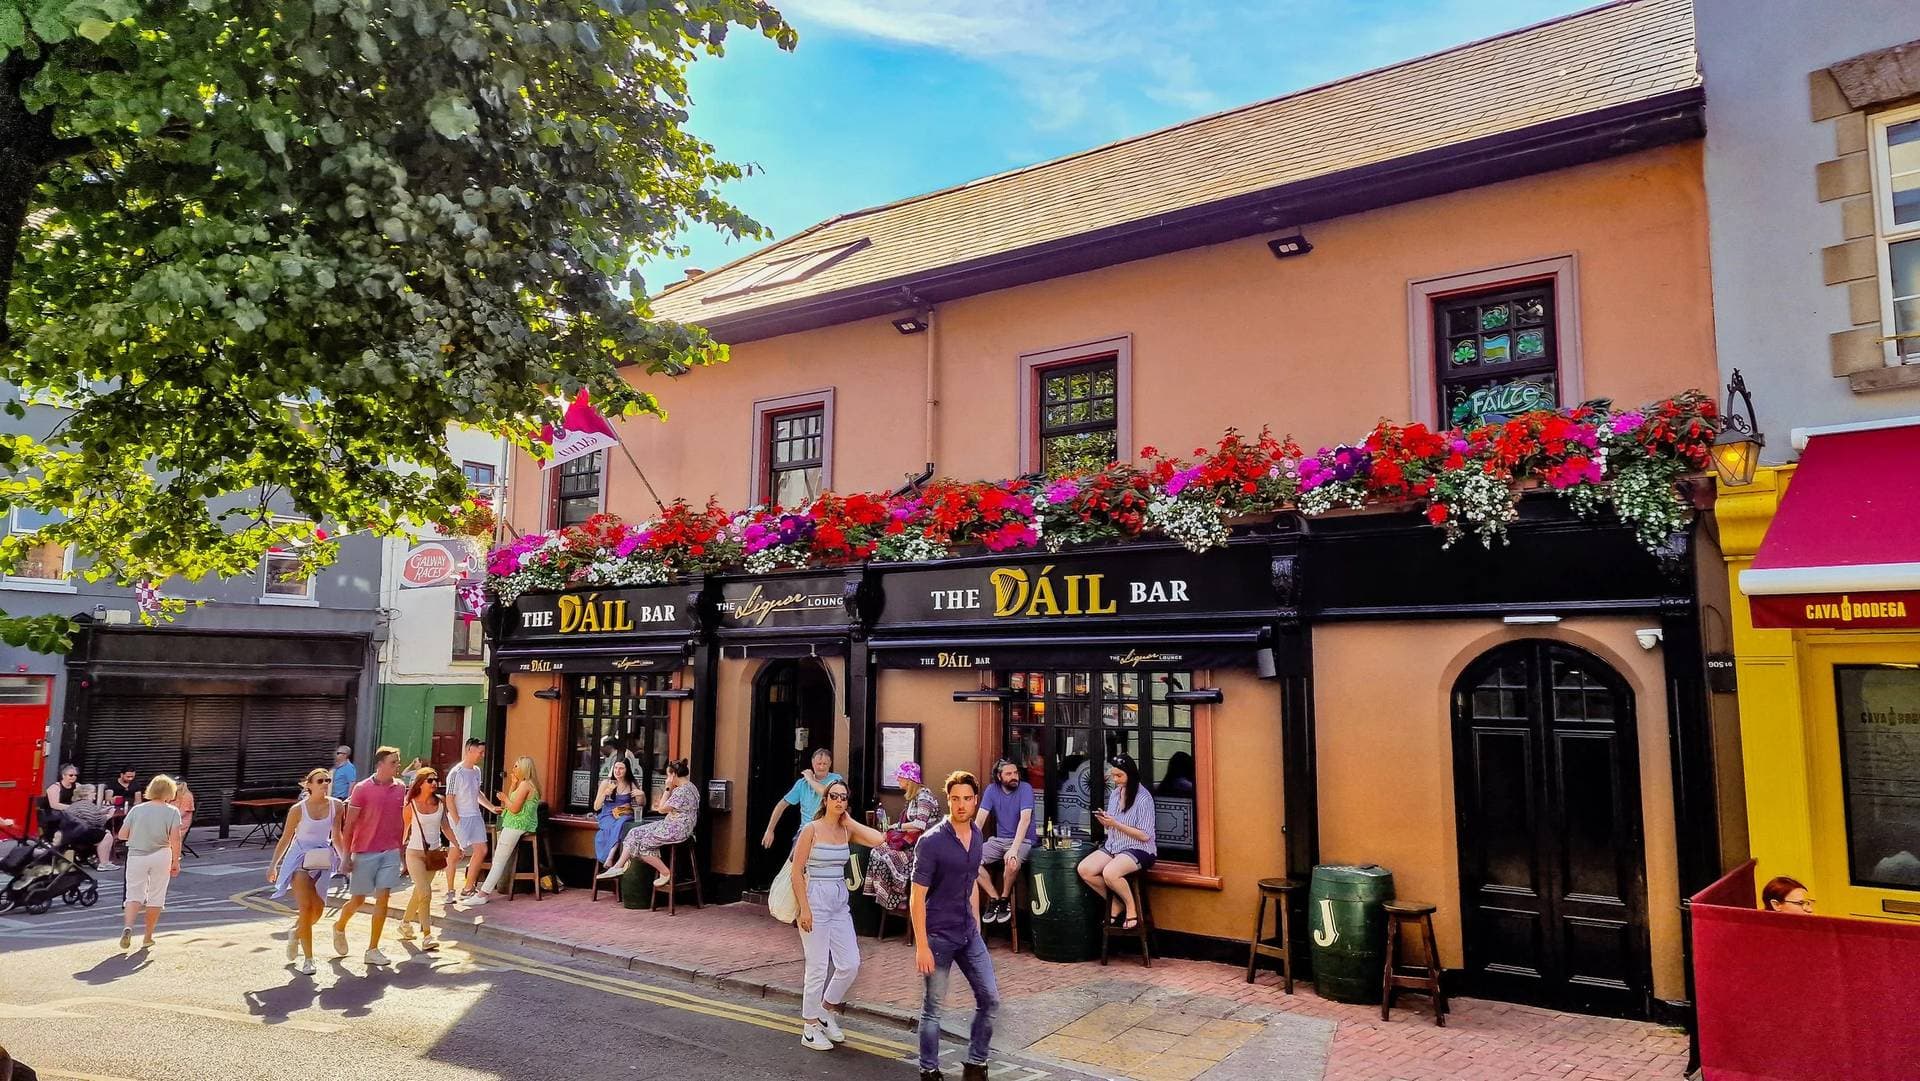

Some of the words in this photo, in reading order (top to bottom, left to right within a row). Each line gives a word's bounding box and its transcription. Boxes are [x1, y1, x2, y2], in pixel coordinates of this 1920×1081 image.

[410, 554, 446, 568] GALWAY
[414, 567, 441, 580] RACES
[930, 589, 980, 610] THE
[989, 565, 1117, 617] DÁIL
[1130, 580, 1189, 603] BAR
[522, 611, 553, 628] THE
[558, 593, 634, 633] DÁIL
[641, 605, 675, 622] BAR
[716, 602, 735, 611] THE
[735, 585, 806, 625] Liquor
[808, 597, 844, 607] LOUNG
[1806, 604, 1840, 619] CAVA
[1853, 602, 1907, 618] BODEGA
[530, 659, 551, 672] DÁIL
[938, 652, 972, 668] DÁIL
[975, 657, 990, 665] BAR
[1861, 712, 1887, 724] CAVA
[1031, 873, 1051, 915] J
[1313, 899, 1340, 947] J
